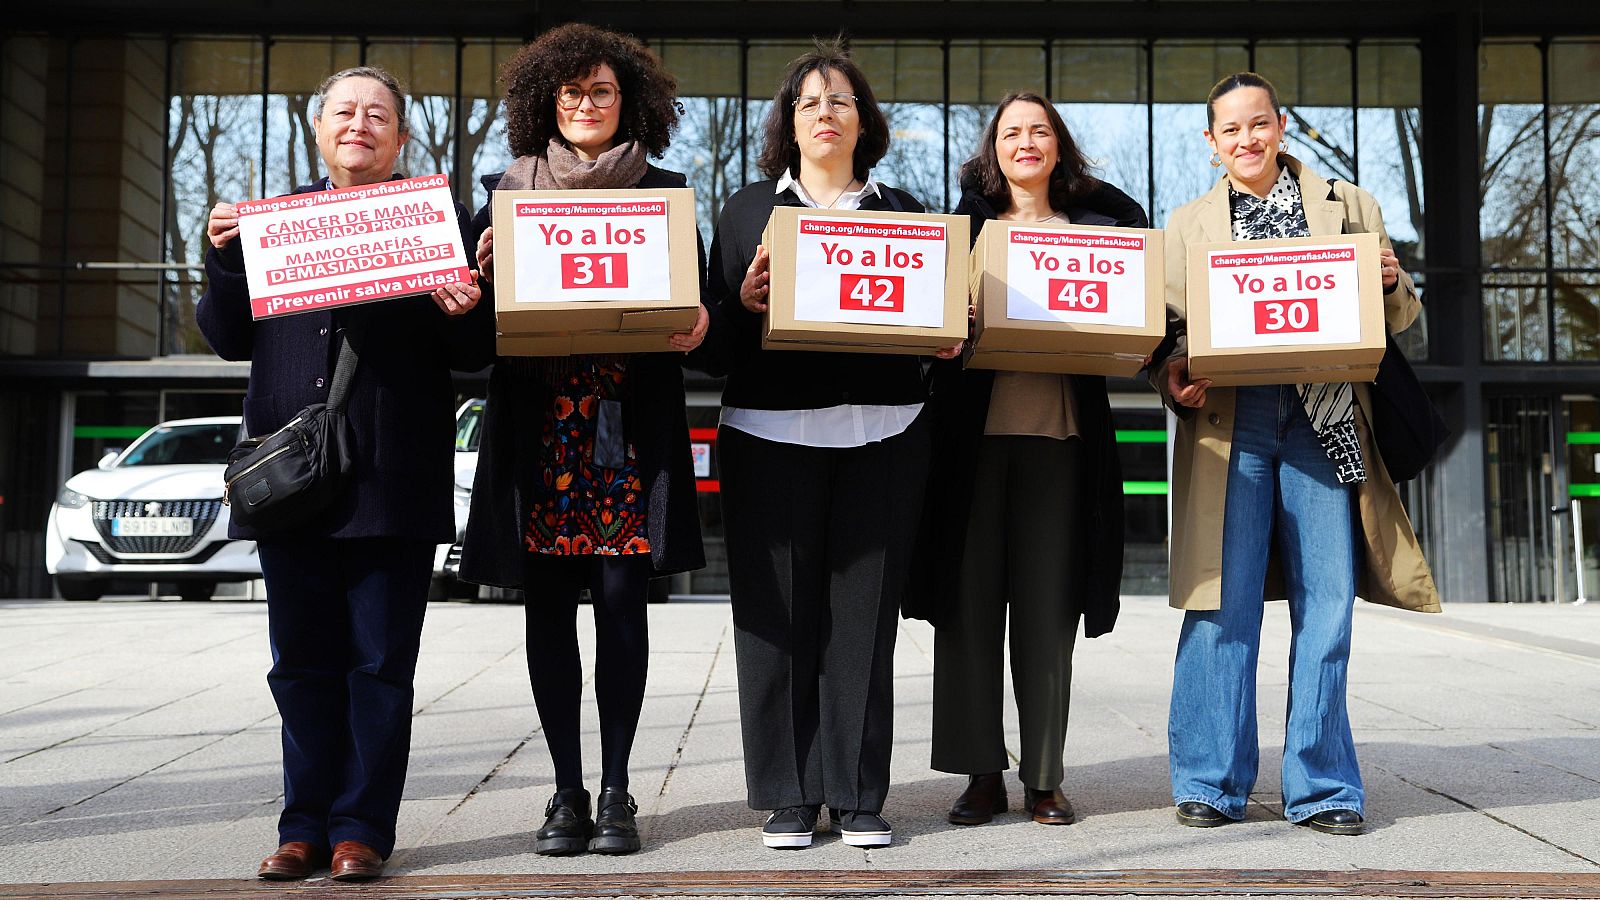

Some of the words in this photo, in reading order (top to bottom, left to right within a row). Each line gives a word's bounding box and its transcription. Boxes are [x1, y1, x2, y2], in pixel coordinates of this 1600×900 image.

[239, 177, 444, 214] change.org/MamografiasAlos40
[266, 214, 340, 236] CÁNCER
[345, 210, 369, 224] DE
[375, 201, 433, 218] MAMA
[520, 204, 661, 215] change.org/MamografiasAlos40
[267, 224, 368, 248] DEMASIADO
[371, 212, 438, 232] PRONTO
[538, 224, 573, 245] Yo
[581, 229, 596, 245] a
[606, 223, 646, 245] los
[804, 223, 941, 237] change.org/MamografiasAlos40
[1014, 234, 1140, 247] change.org/MamografiasAlos40
[271, 257, 386, 284] DEMASIADO
[386, 244, 451, 265] TARDE
[286, 236, 423, 266] MAMOGRAFÍAS
[821, 243, 853, 265] Yo
[861, 250, 876, 266] a
[885, 245, 924, 269] los
[1030, 251, 1059, 271] Yo
[1067, 258, 1080, 272] a
[1090, 253, 1125, 275] los
[1215, 251, 1351, 265] change.org/MamografiasAlos40
[573, 256, 613, 284] 31
[1232, 274, 1265, 294] Yo
[1273, 277, 1287, 292] a
[1297, 270, 1336, 290] los
[267, 288, 350, 314] ¡Prevenir
[356, 277, 402, 296] salva
[406, 270, 460, 290] vidas!
[850, 278, 895, 308] 42
[1058, 283, 1100, 309] 46
[1265, 302, 1310, 330] 30
